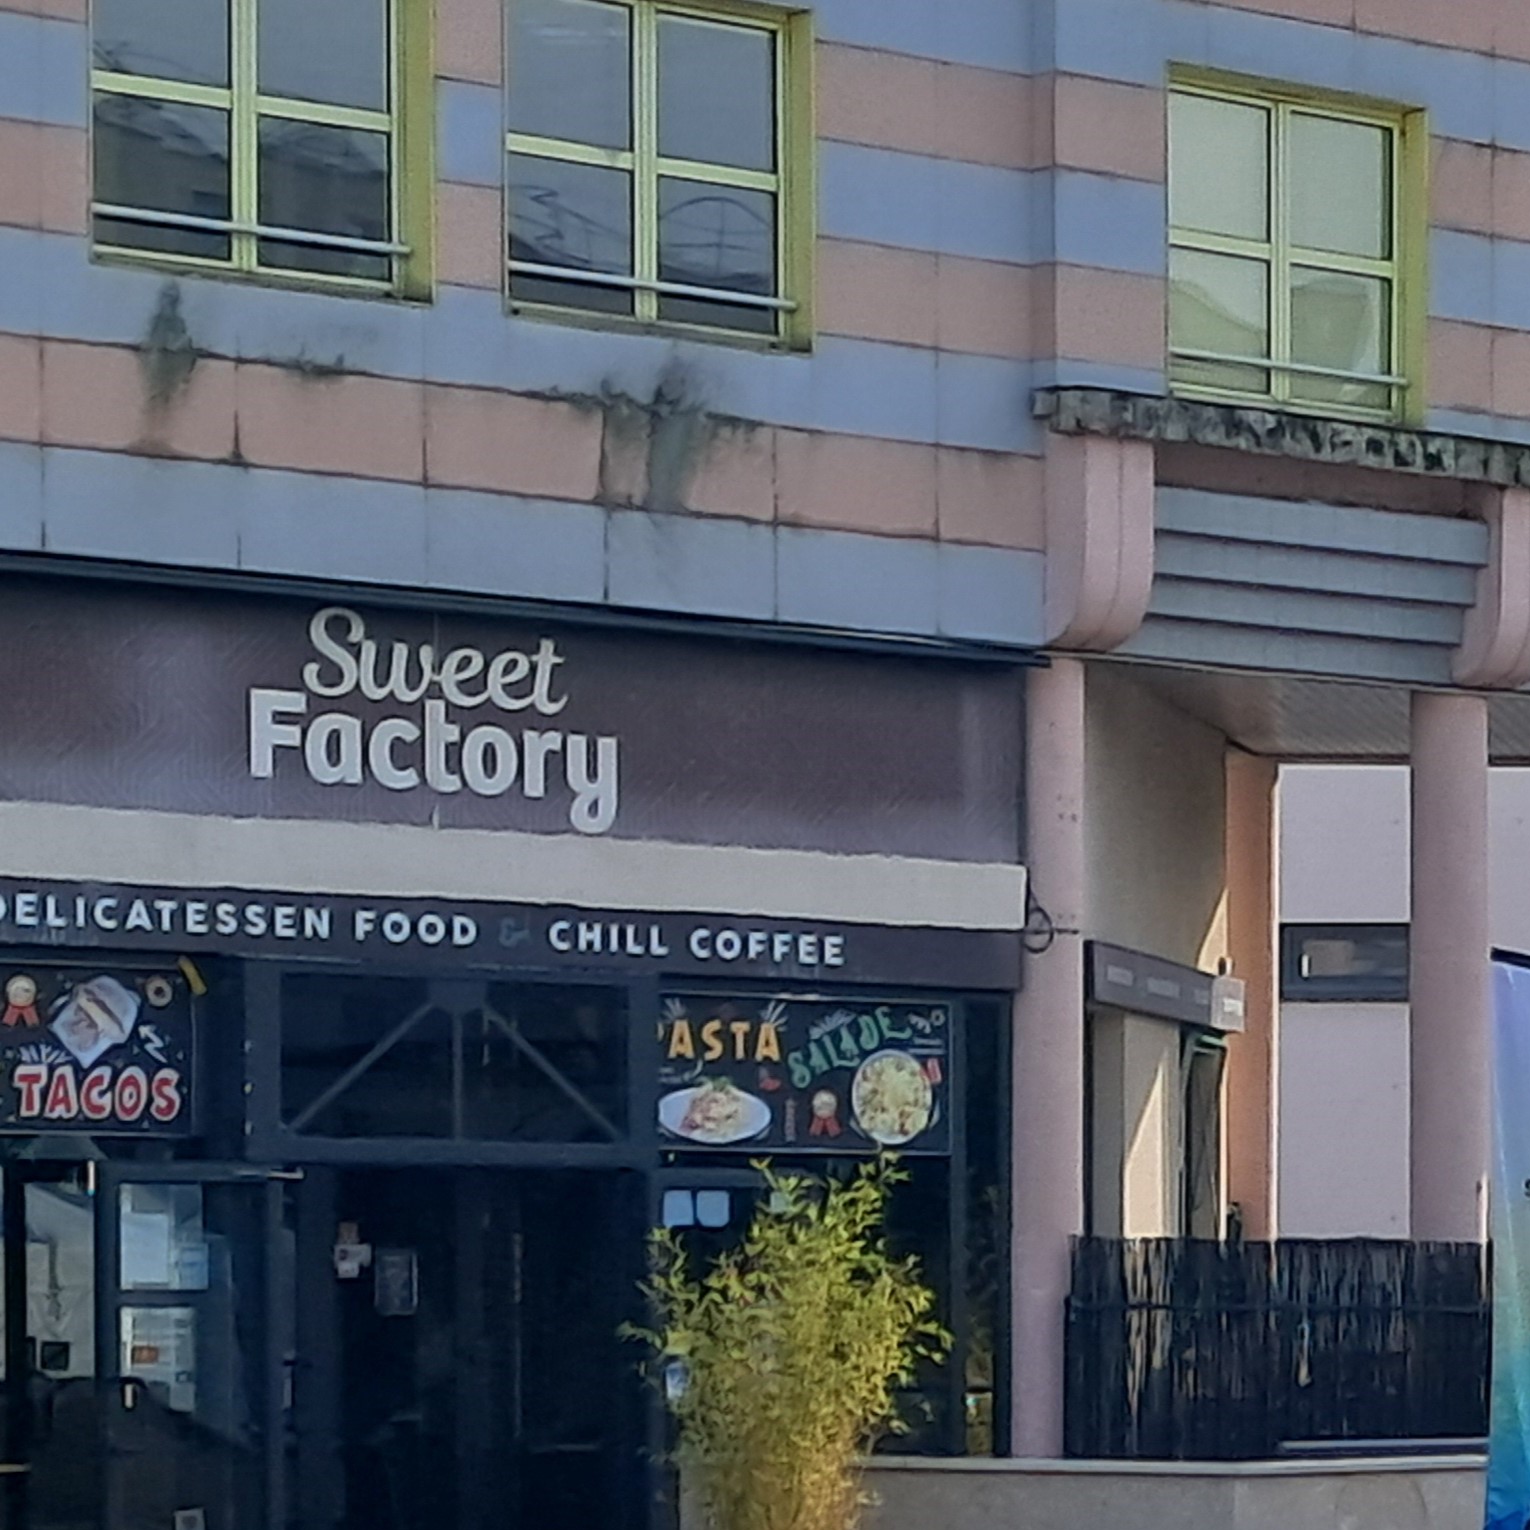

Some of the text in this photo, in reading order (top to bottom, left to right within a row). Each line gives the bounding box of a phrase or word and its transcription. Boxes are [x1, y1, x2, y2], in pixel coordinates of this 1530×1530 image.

[302, 606, 569, 716] Sweet
[249, 687, 619, 834] Factory
[0, 892, 331, 940] ELICATESSEN
[354, 909, 478, 946] FOOD
[548, 920, 670, 957] CHILL
[690, 927, 846, 967] COFFEE
[657, 1018, 780, 1062] ASTA
[787, 1006, 912, 1088] SALADE
[13, 1064, 182, 1122] TACOS
